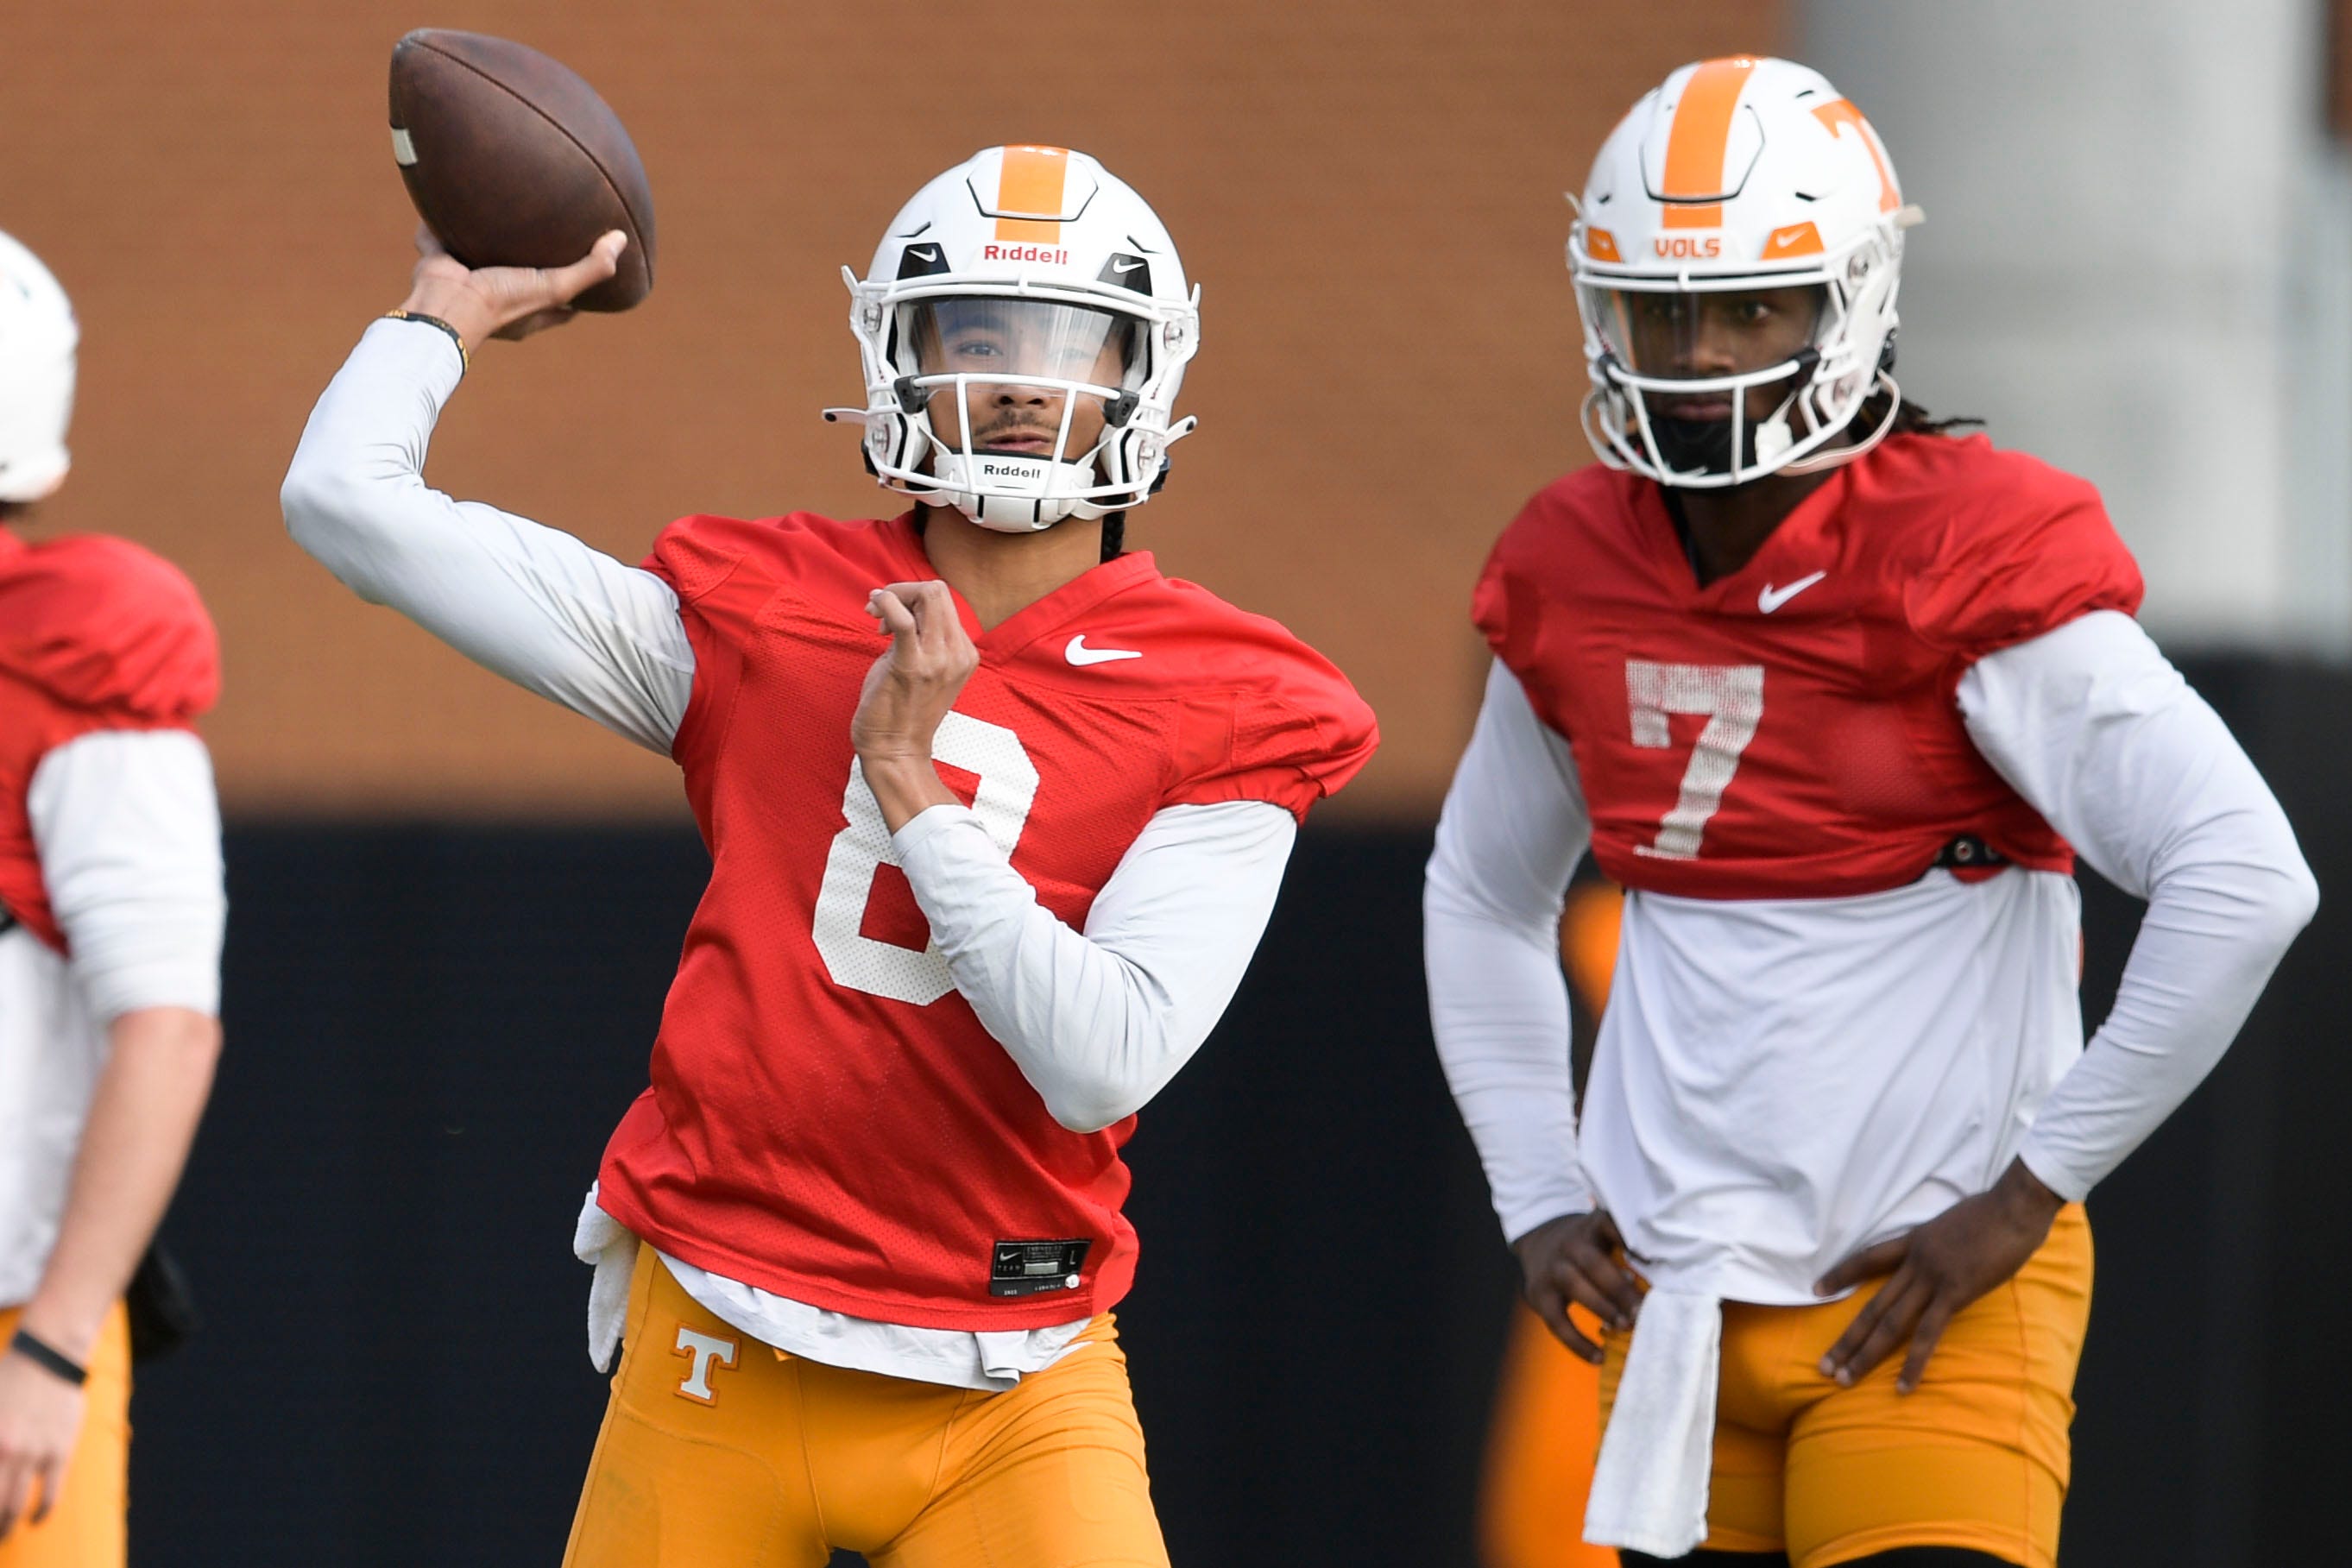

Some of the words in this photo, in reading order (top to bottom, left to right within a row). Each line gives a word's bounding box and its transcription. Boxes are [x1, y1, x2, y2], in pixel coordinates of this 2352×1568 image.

[984, 245, 1068, 265] Riddell
[1655, 238, 1720, 257] VOLS
[984, 464, 1041, 479] Riddell
[1625, 658, 1765, 861] 7
[811, 709, 1040, 1007] 8
[672, 1324, 738, 1404] T
